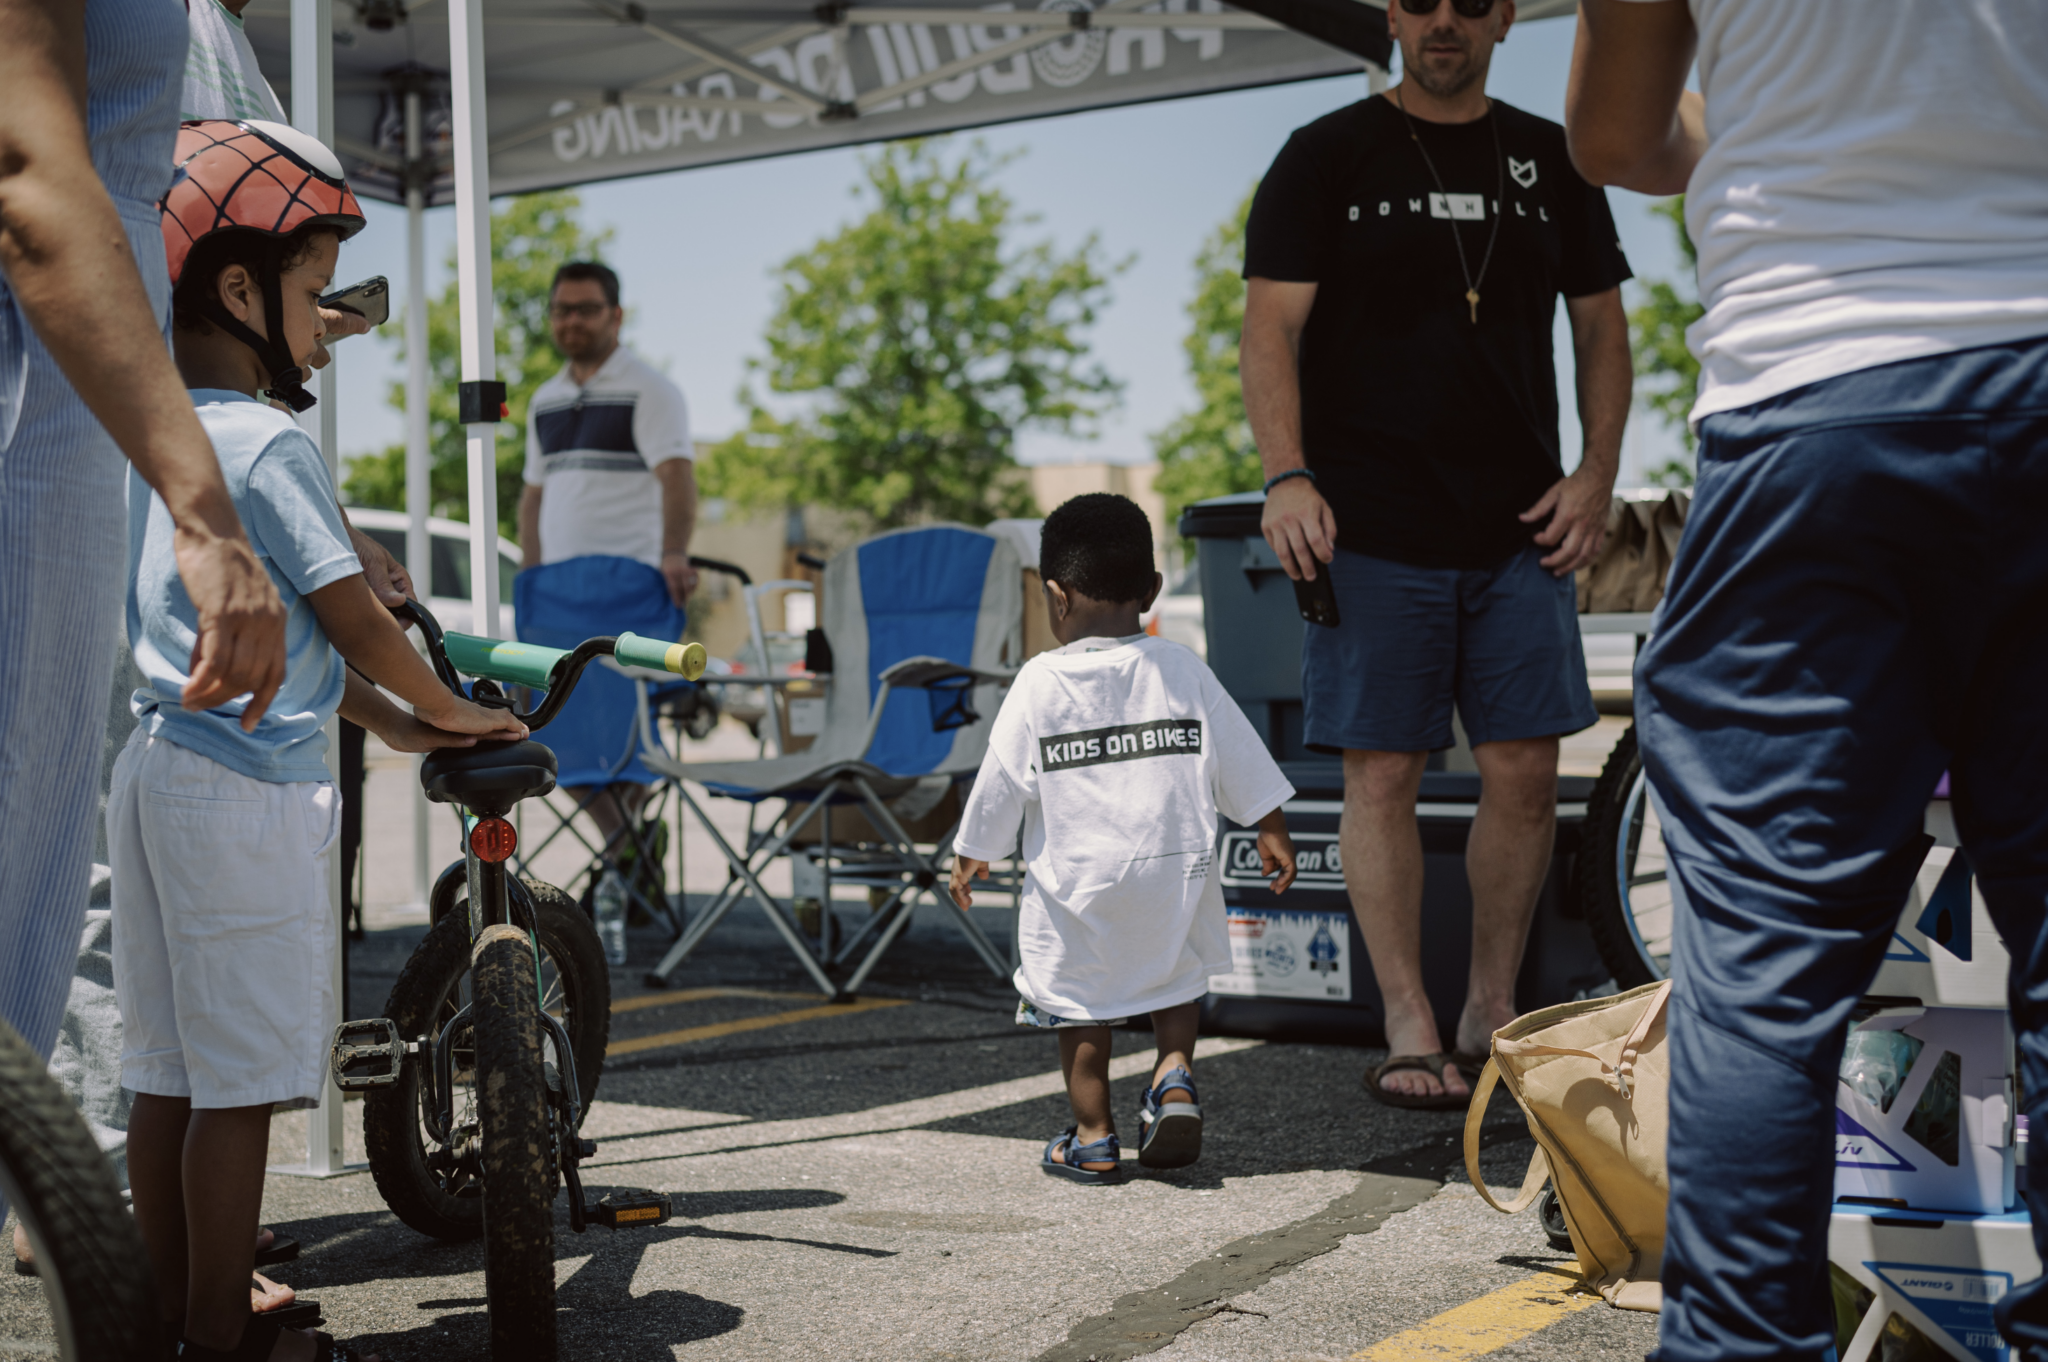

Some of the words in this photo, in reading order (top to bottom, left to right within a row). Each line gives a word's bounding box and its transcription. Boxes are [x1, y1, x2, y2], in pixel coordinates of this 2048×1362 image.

[1349, 198, 1549, 222] DOWNHILL
[1046, 737, 1101, 764] KIDS
[1142, 727, 1201, 751] BIKES
[1233, 839, 1323, 871] Coan
[1900, 1277, 1943, 1291] GIANT
